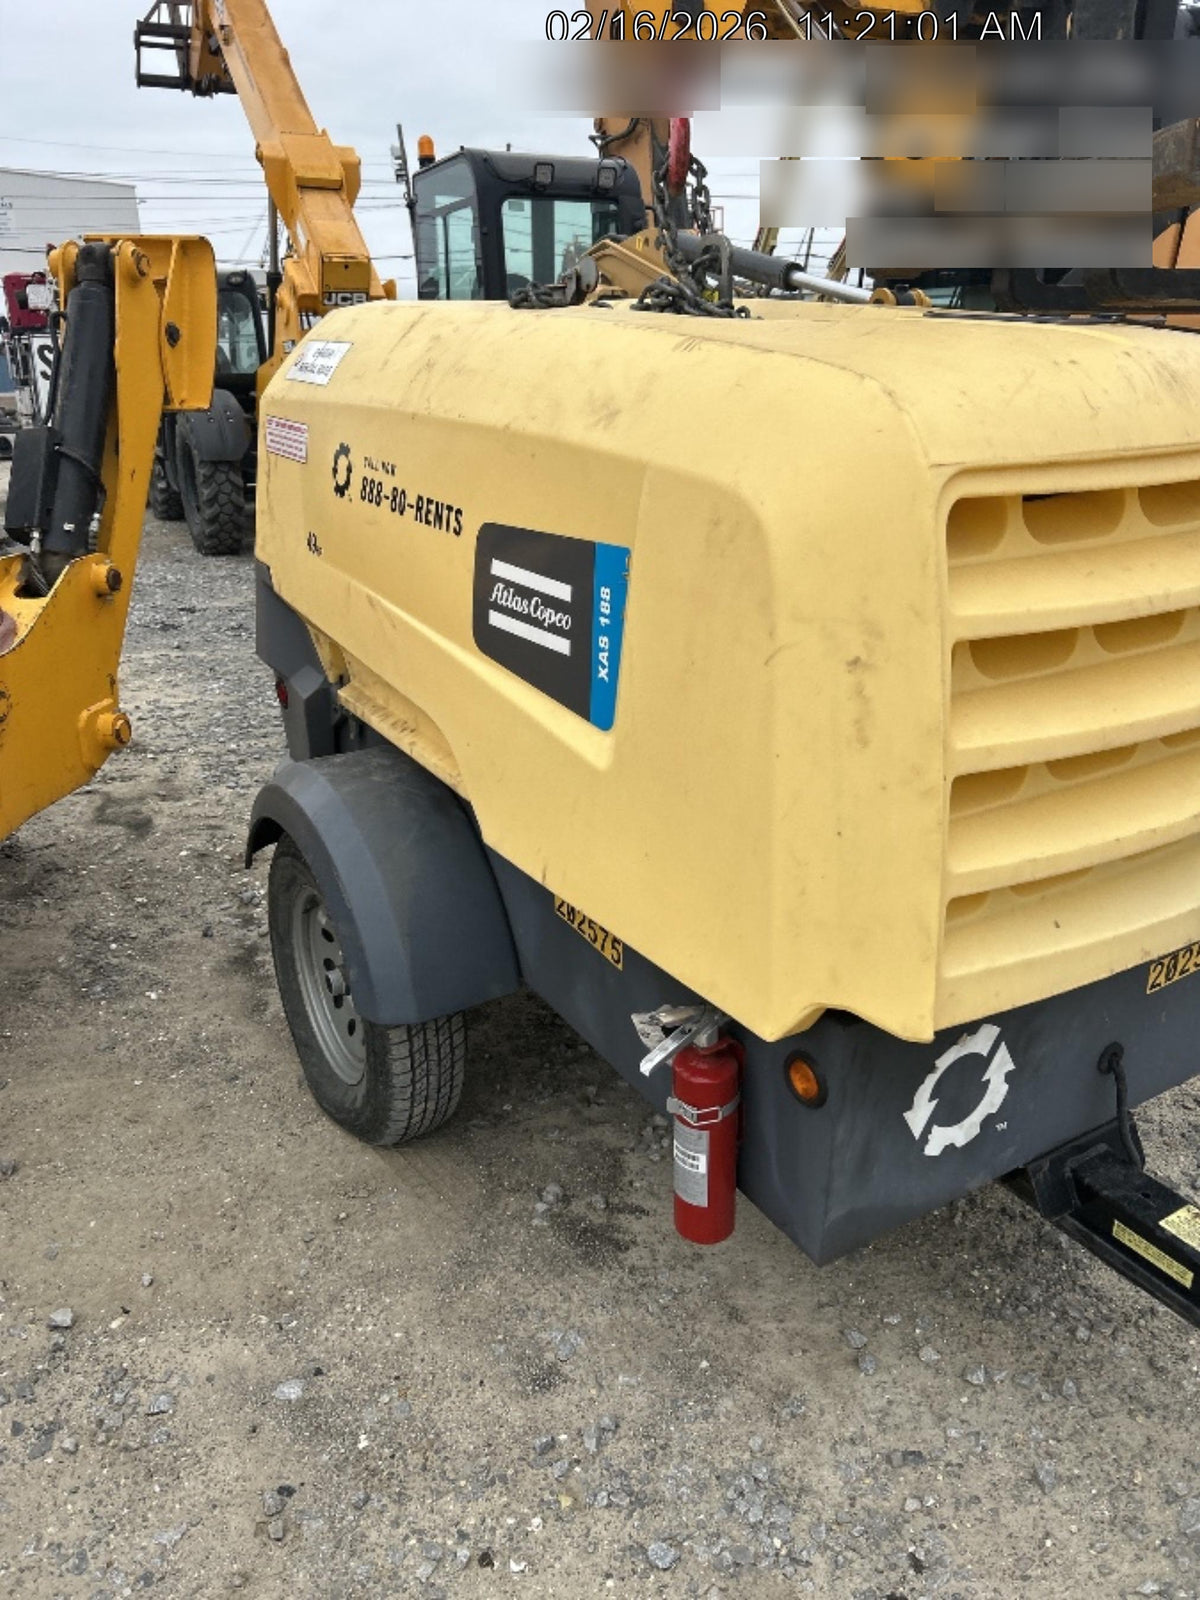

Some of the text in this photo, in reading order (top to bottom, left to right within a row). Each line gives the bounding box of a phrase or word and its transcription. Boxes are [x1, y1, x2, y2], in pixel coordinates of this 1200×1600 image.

[323, 292, 367, 306] JCB
[360, 476, 463, 537] 888-80-RENTS
[490, 582, 572, 630] Atlas Copco
[598, 586, 611, 683] XAS 188
[556, 900, 621, 965] 202575
